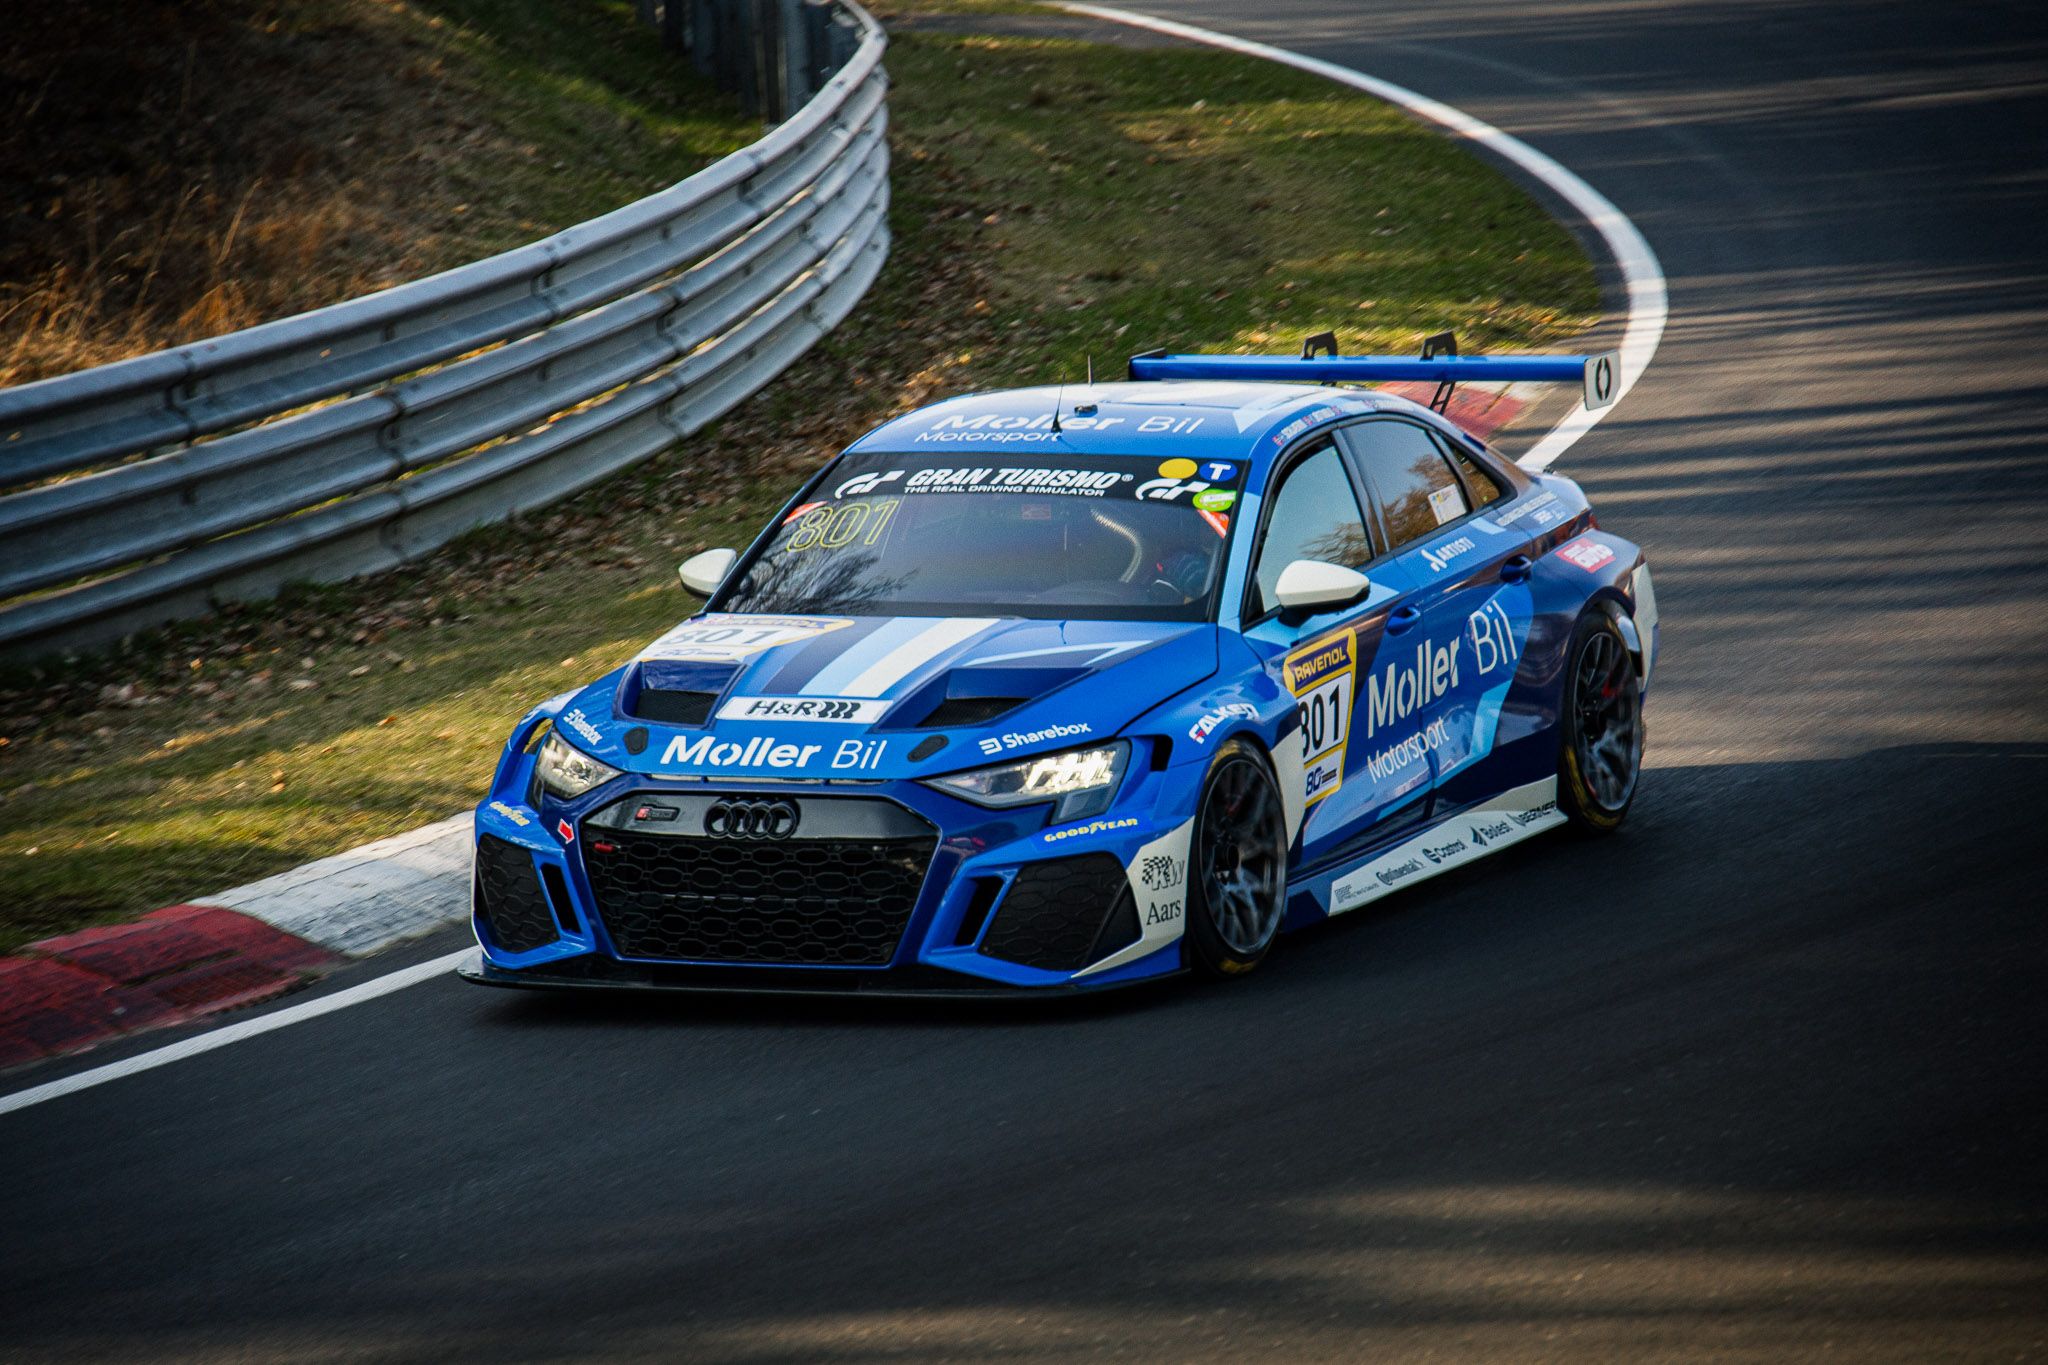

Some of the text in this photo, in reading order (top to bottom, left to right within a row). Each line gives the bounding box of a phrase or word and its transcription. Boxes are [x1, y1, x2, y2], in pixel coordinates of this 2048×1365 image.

[915, 431, 1063, 443] Motorsport
[1137, 416, 1205, 434] Bil
[907, 468, 993, 486] GRAN
[904, 485, 1105, 497] THE REAL DRIVING SIMULATOR
[786, 500, 899, 552] 801
[1469, 599, 1518, 676] Bil
[1295, 647, 1346, 682] RAVENOL
[745, 700, 817, 715] H&R
[1002, 722, 1092, 749] Sharebox
[831, 740, 888, 769] Bil
[1367, 716, 1450, 784] Motorsport
[1044, 818, 1138, 842] GOODYEAR
[1146, 900, 1181, 926] Aars
